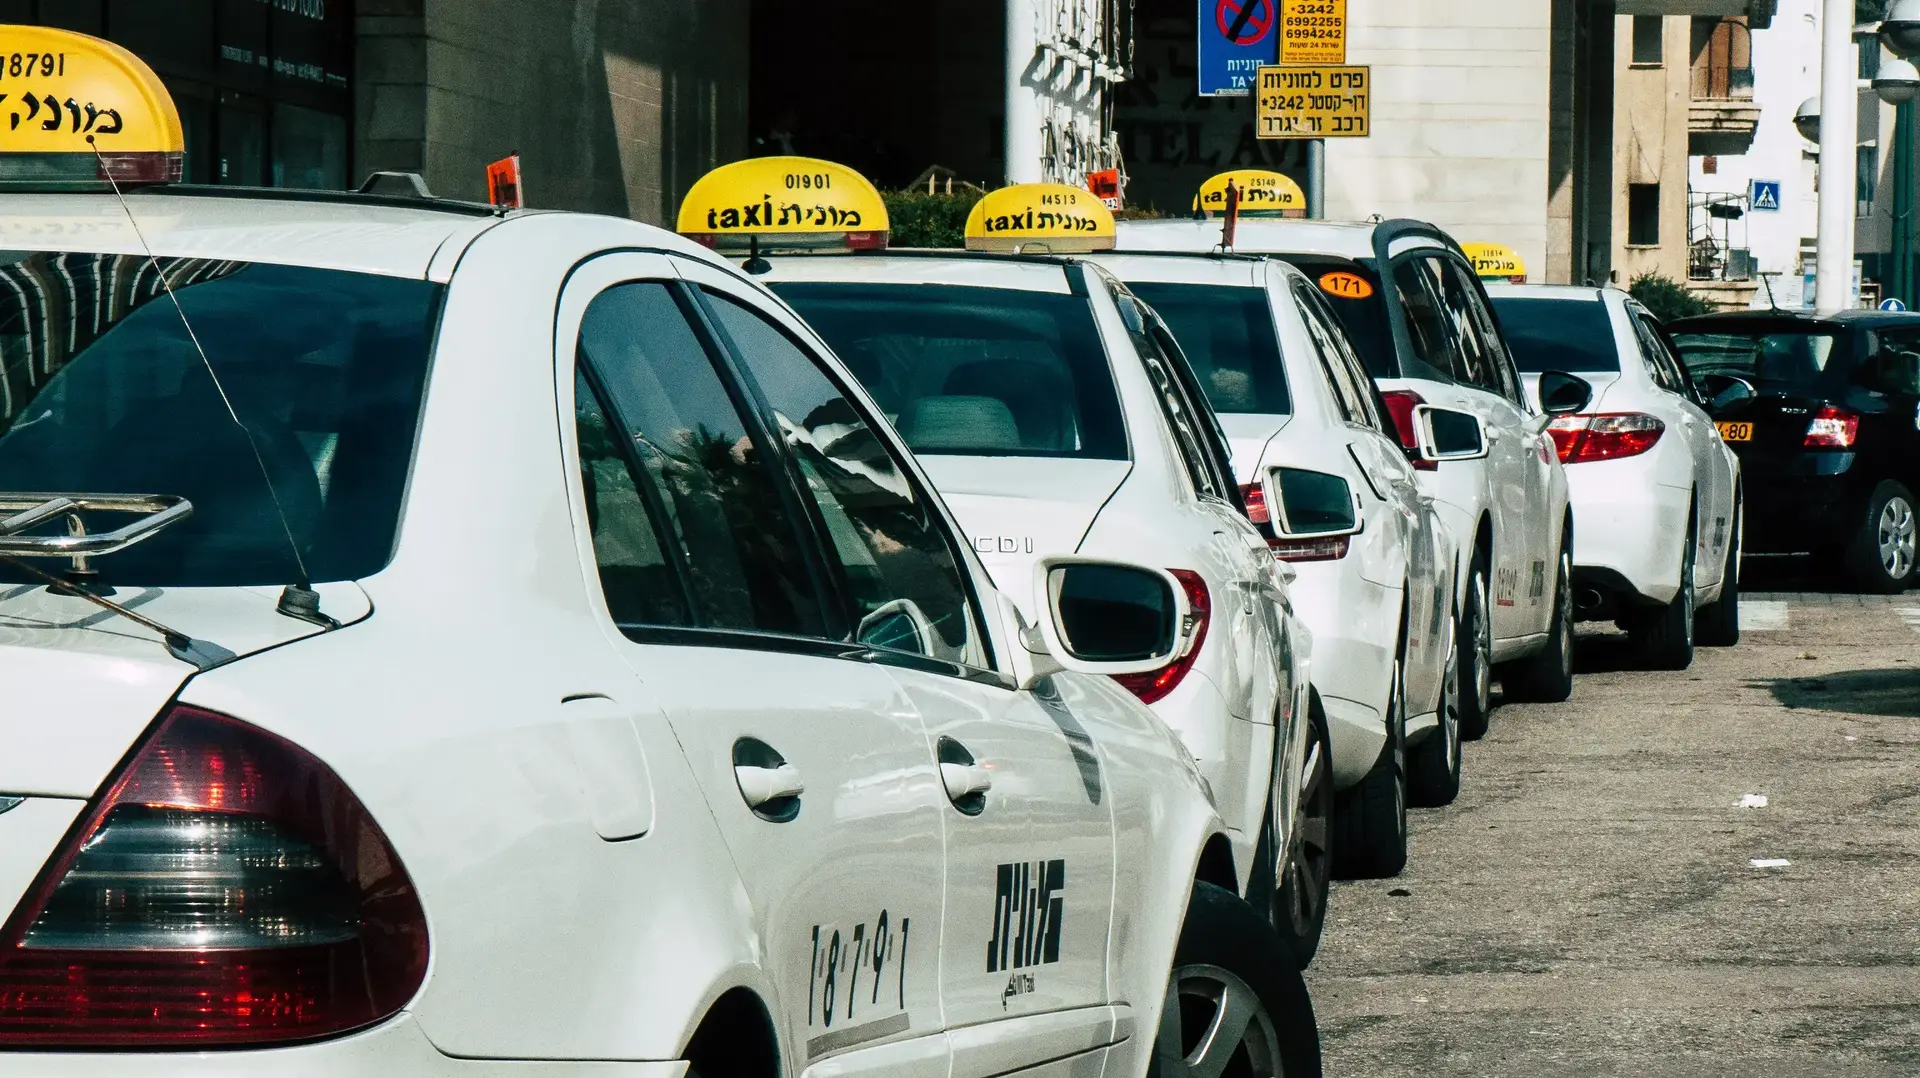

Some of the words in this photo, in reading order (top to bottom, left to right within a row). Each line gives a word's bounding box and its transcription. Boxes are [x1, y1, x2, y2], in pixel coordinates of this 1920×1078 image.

[1286, 17, 1342, 27] 6992255
[1286, 28, 1342, 39] 6994242
[1263, 70, 1322, 88] למוניות
[1330, 72, 1364, 88] פרט
[1262, 116, 1299, 132] יגרר
[1306, 116, 1322, 132] זר
[1331, 116, 1364, 132] רכב
[785, 174, 830, 189] 01901
[1250, 178, 1276, 187] 25149
[1042, 194, 1076, 205] 14513
[1204, 186, 1244, 203] tai
[1248, 189, 1292, 203] מונית
[707, 194, 773, 229] taxi
[778, 203, 862, 227] מונית
[984, 206, 1032, 232] taxi
[1036, 211, 1098, 232] מונית
[1478, 259, 1515, 271] מונית
[1330, 276, 1361, 294] 171
[974, 535, 1033, 554] CDI
[808, 908, 910, 1028] 18791
